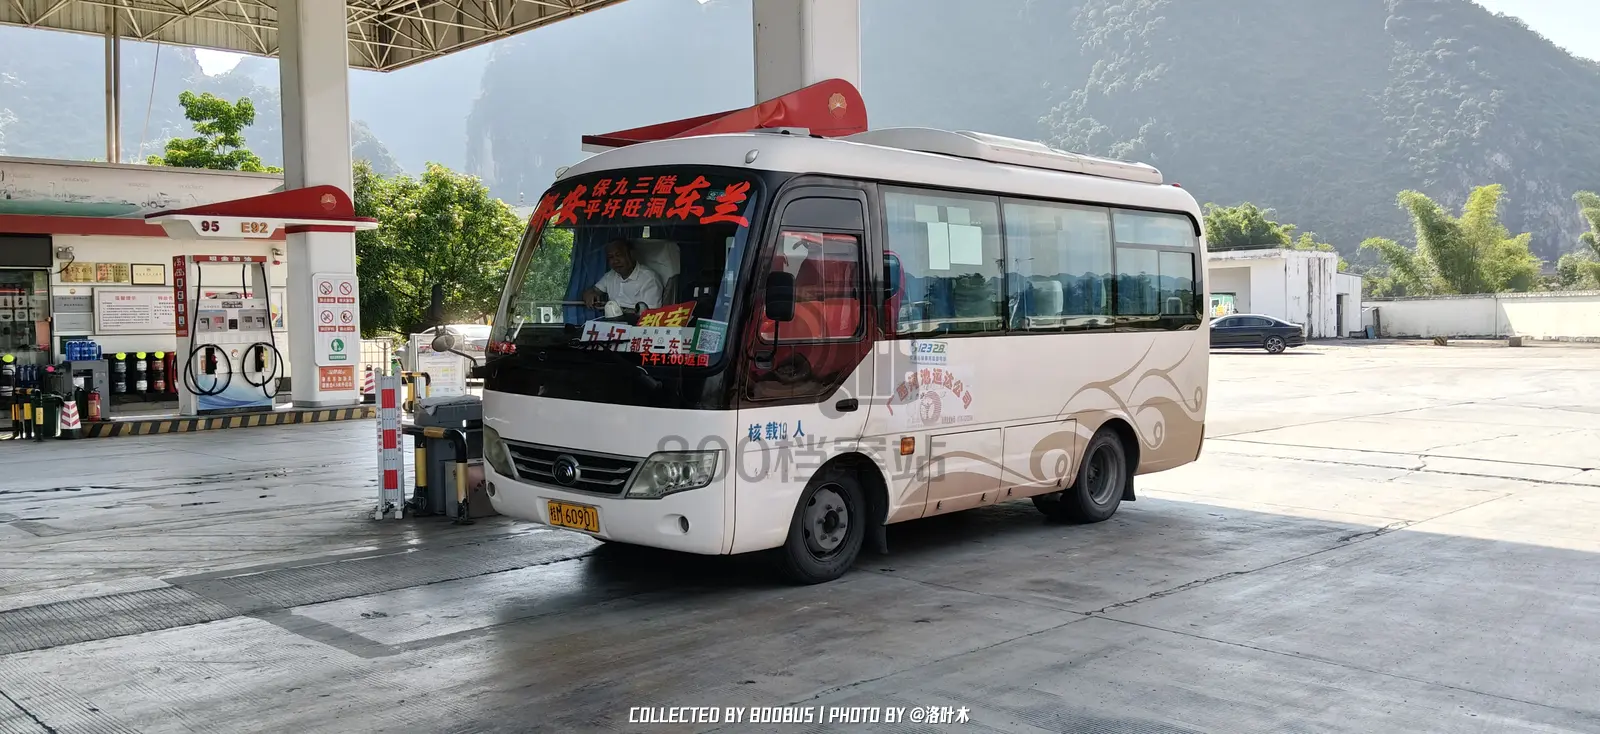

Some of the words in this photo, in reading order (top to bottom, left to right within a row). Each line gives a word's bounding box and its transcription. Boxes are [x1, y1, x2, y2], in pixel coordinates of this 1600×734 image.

[591, 175, 677, 197] 保九三隘
[584, 198, 667, 220] 平圩旺洞
[666, 175, 750, 228] 东兰
[201, 220, 220, 233] 95
[241, 221, 269, 234] E92
[639, 306, 691, 327] 都安
[640, 352, 710, 367] 下午1:00返回
